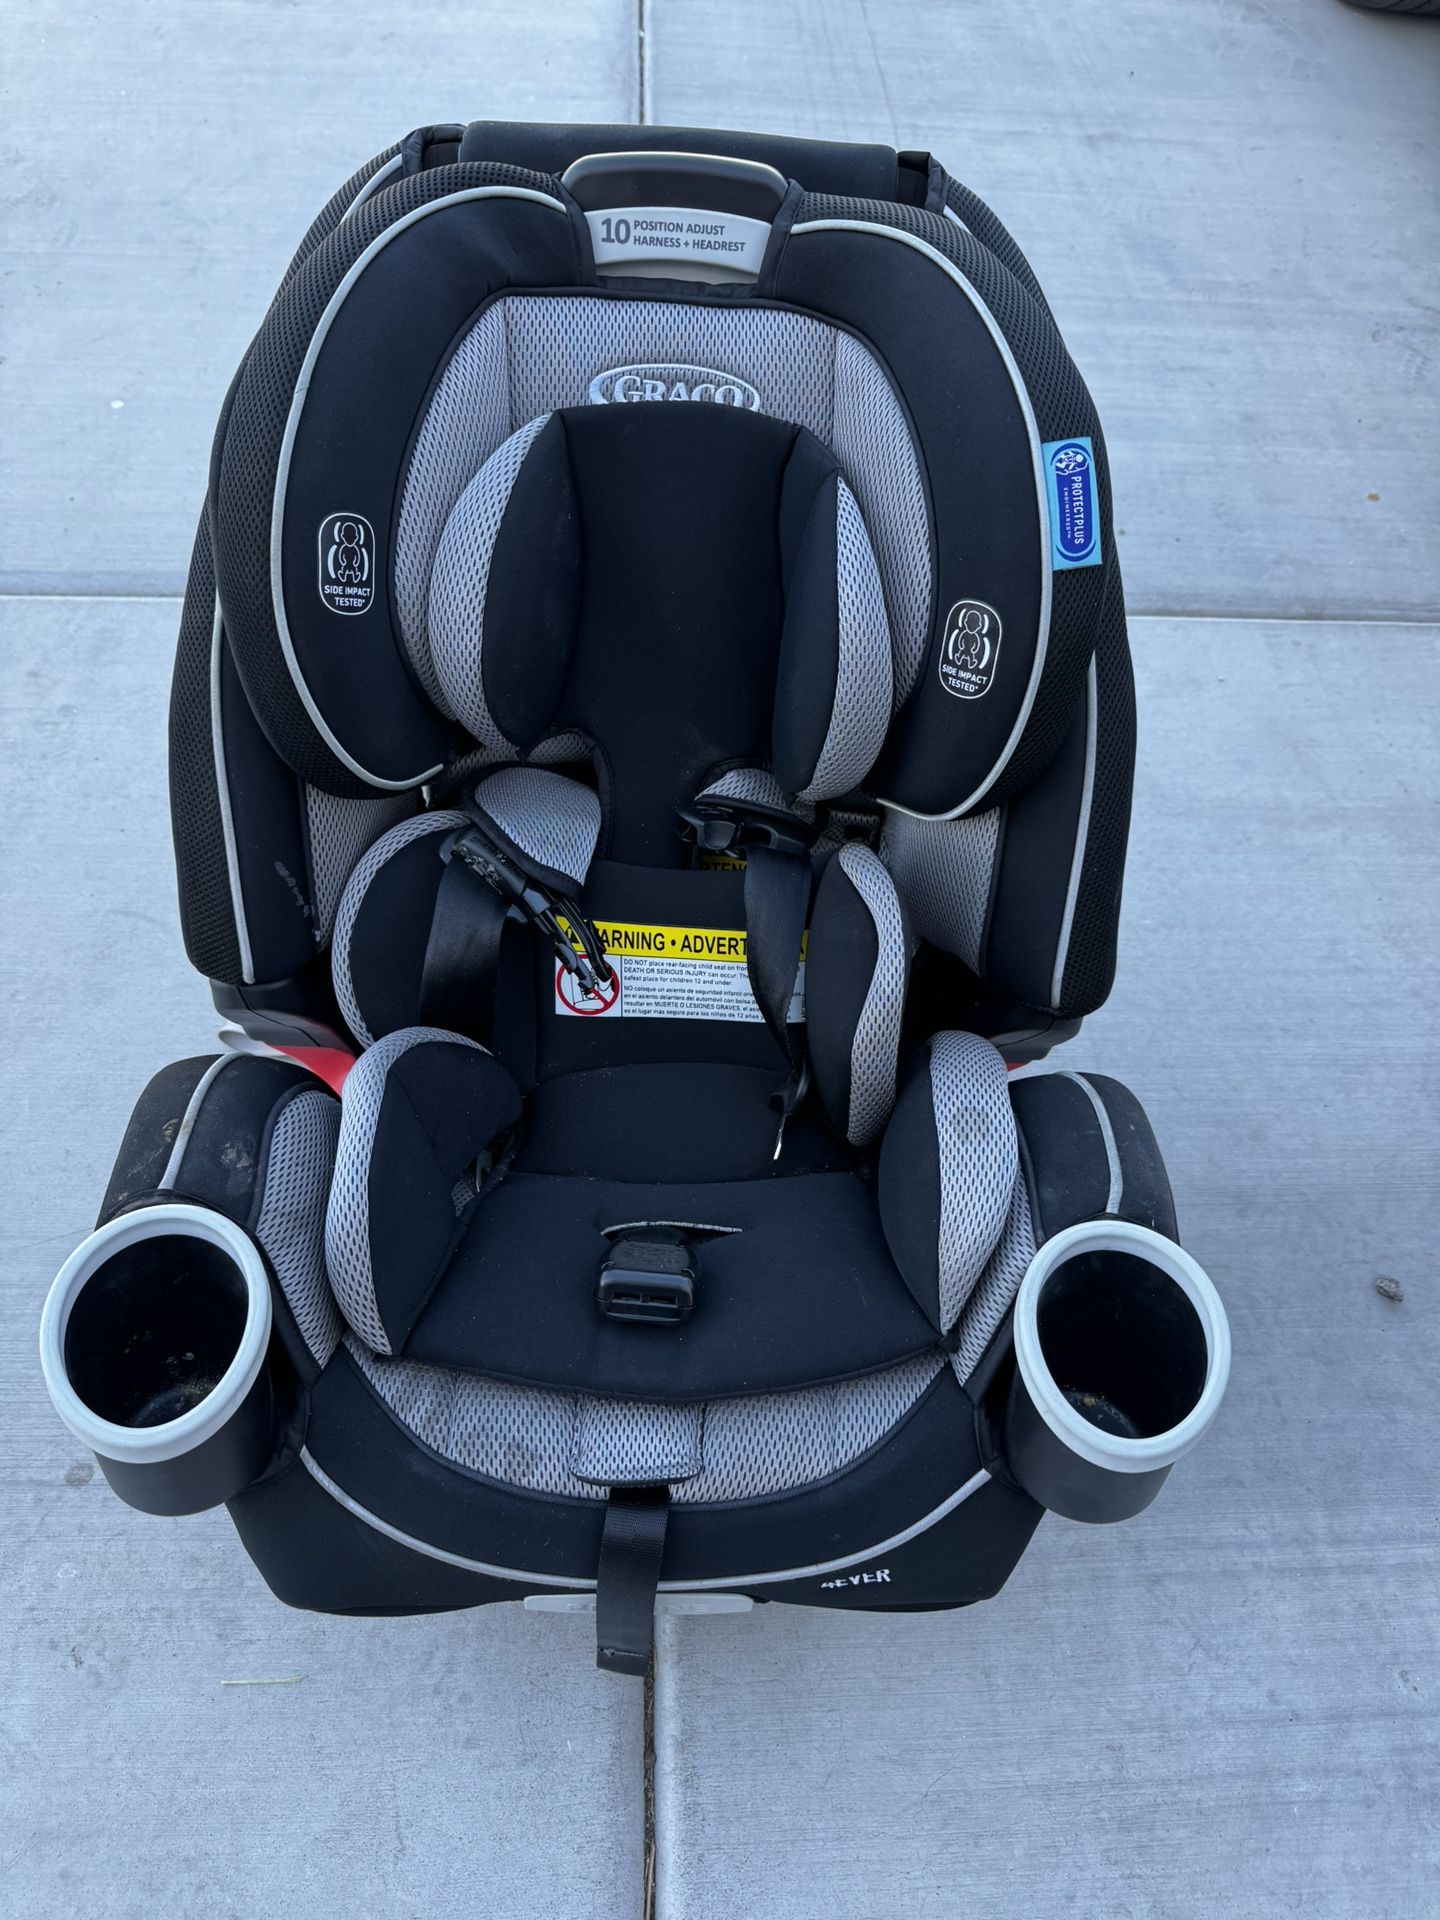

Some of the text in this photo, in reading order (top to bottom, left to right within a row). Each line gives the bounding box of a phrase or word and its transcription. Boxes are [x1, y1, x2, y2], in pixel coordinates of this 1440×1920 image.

[600, 217, 631, 244] 10
[633, 220, 726, 236] POSITION ADJUST
[633, 235, 681, 248] HARNESS
[692, 240, 746, 252] HEADREST
[613, 375, 744, 408] GRACO
[1071, 476, 1085, 545] PROTECTPLUS
[324, 585, 371, 597] SIDE IMPACT
[941, 664, 988, 685] SIDE IMPACT
[599, 928, 748, 956] ARNING ADVERT
[648, 960, 665, 968] place
[666, 961, 697, 969] rear-facing
[686, 1002, 714, 1010] LESIONES
[820, 1569, 891, 1589] 4EVER
